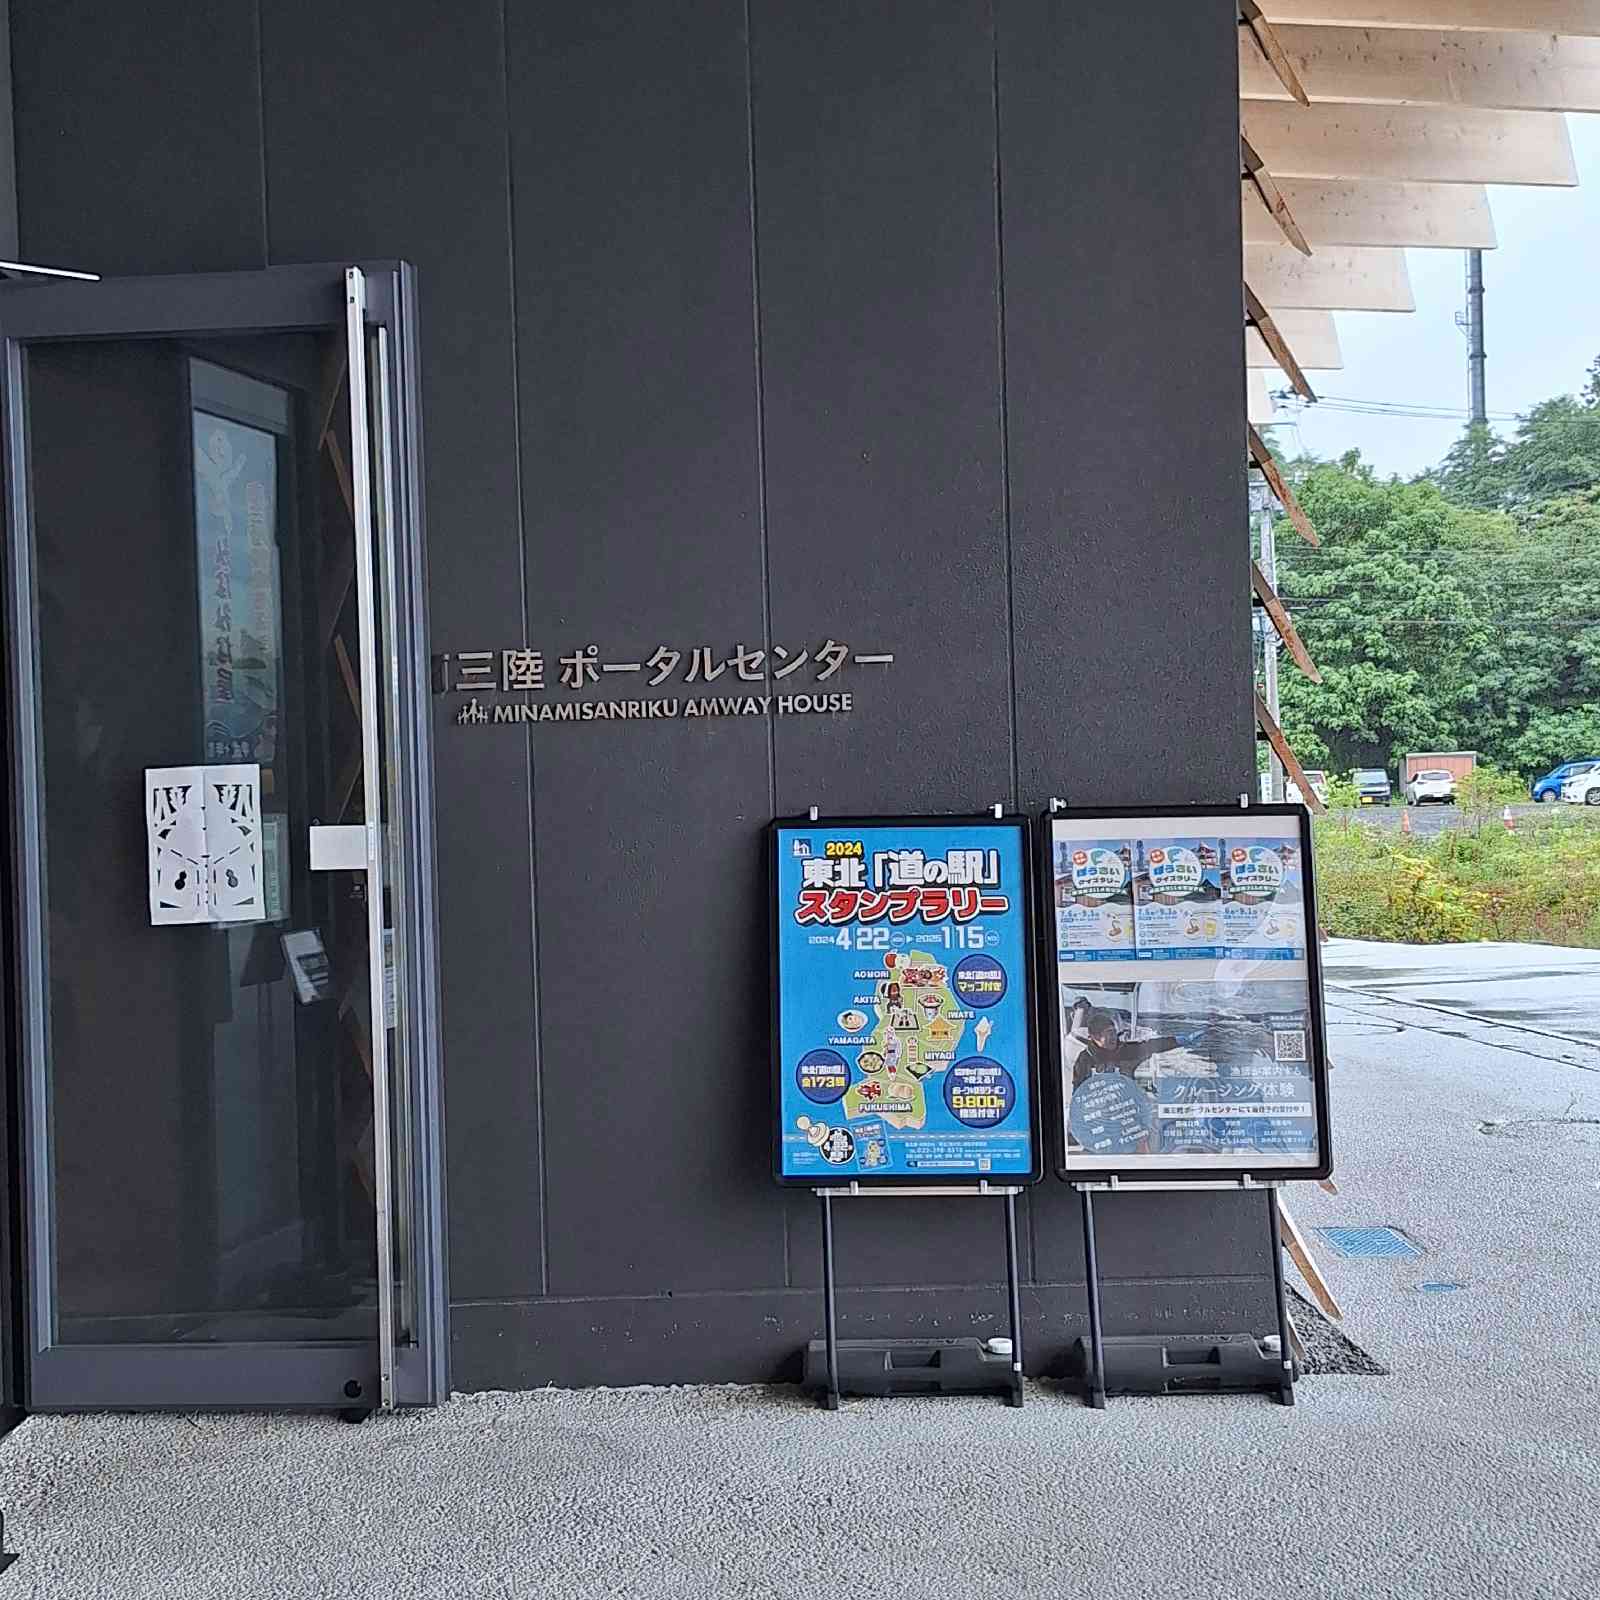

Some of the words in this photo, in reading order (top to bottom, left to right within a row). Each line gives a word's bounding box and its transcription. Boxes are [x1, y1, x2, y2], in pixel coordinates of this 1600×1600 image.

[559, 640, 894, 690] ポータルセンター
[493, 699, 679, 723] MINAMISANRIKU
[683, 696, 771, 718] AMWAY
[777, 693, 853, 714] HOUSE
[826, 841, 863, 856] 2024
[802, 850, 999, 888] 東北「道の駅」
[796, 889, 1008, 923] スタンプラリー
[836, 929, 852, 950] 4
[856, 928, 889, 950] 22
[854, 970, 889, 979] AOMORI
[854, 996, 880, 1005] AKITA
[947, 1010, 975, 1019] IWATE
[829, 1037, 875, 1046] YAMAGATA
[925, 1051, 955, 1061] MIYAGI
[1173, 1081, 1296, 1098] クルージング体験
[859, 1102, 912, 1112] FUKUSHIMA
